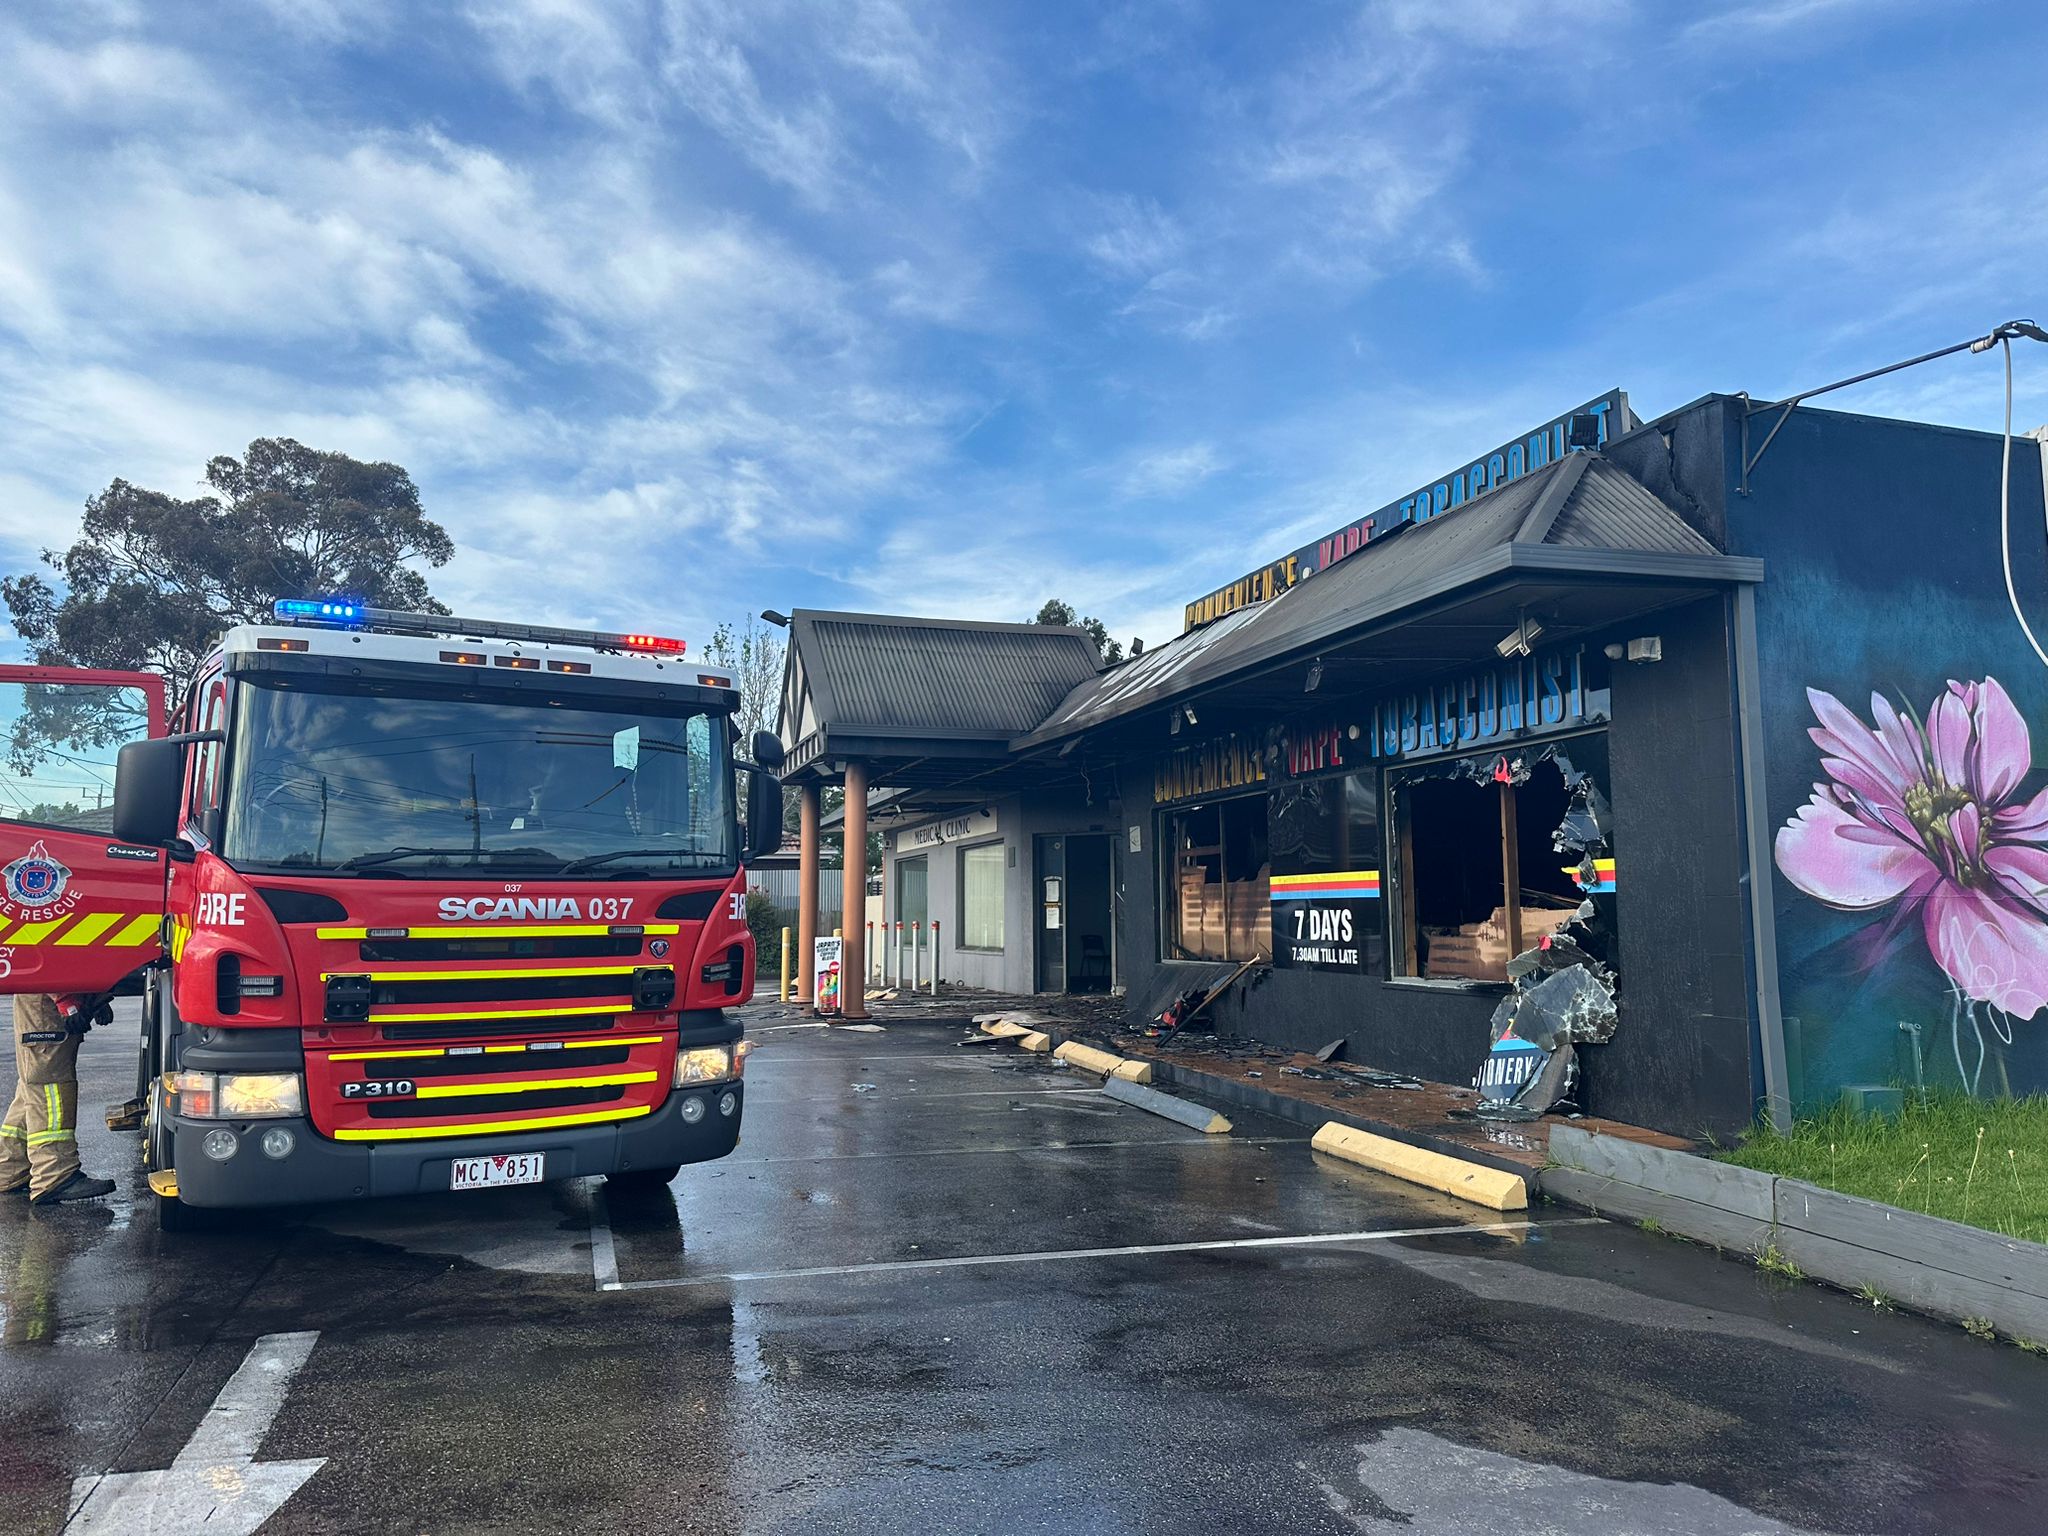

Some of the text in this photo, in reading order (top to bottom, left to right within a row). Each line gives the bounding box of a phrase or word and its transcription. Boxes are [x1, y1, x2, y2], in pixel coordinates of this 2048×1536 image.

[1319, 519, 1374, 571] VAPE
[1400, 401, 1611, 523] TOBACCONIT
[1288, 722, 1343, 777] VAPE
[1370, 643, 1585, 758] TOBACCONIST
[946, 817, 970, 838] CLINIC
[21, 889, 50, 898] VICTORIA
[504, 884, 522, 893] 037
[20, 890, 83, 921] RESCUE
[197, 893, 247, 926] FIRE
[438, 897, 634, 921] SCANIA 037
[1294, 908, 1353, 942] 7 DAYS
[1292, 947, 1358, 964] 7.30AM TILL LATE
[345, 1081, 412, 1097] P 310
[455, 1157, 539, 1183] MCI 851
